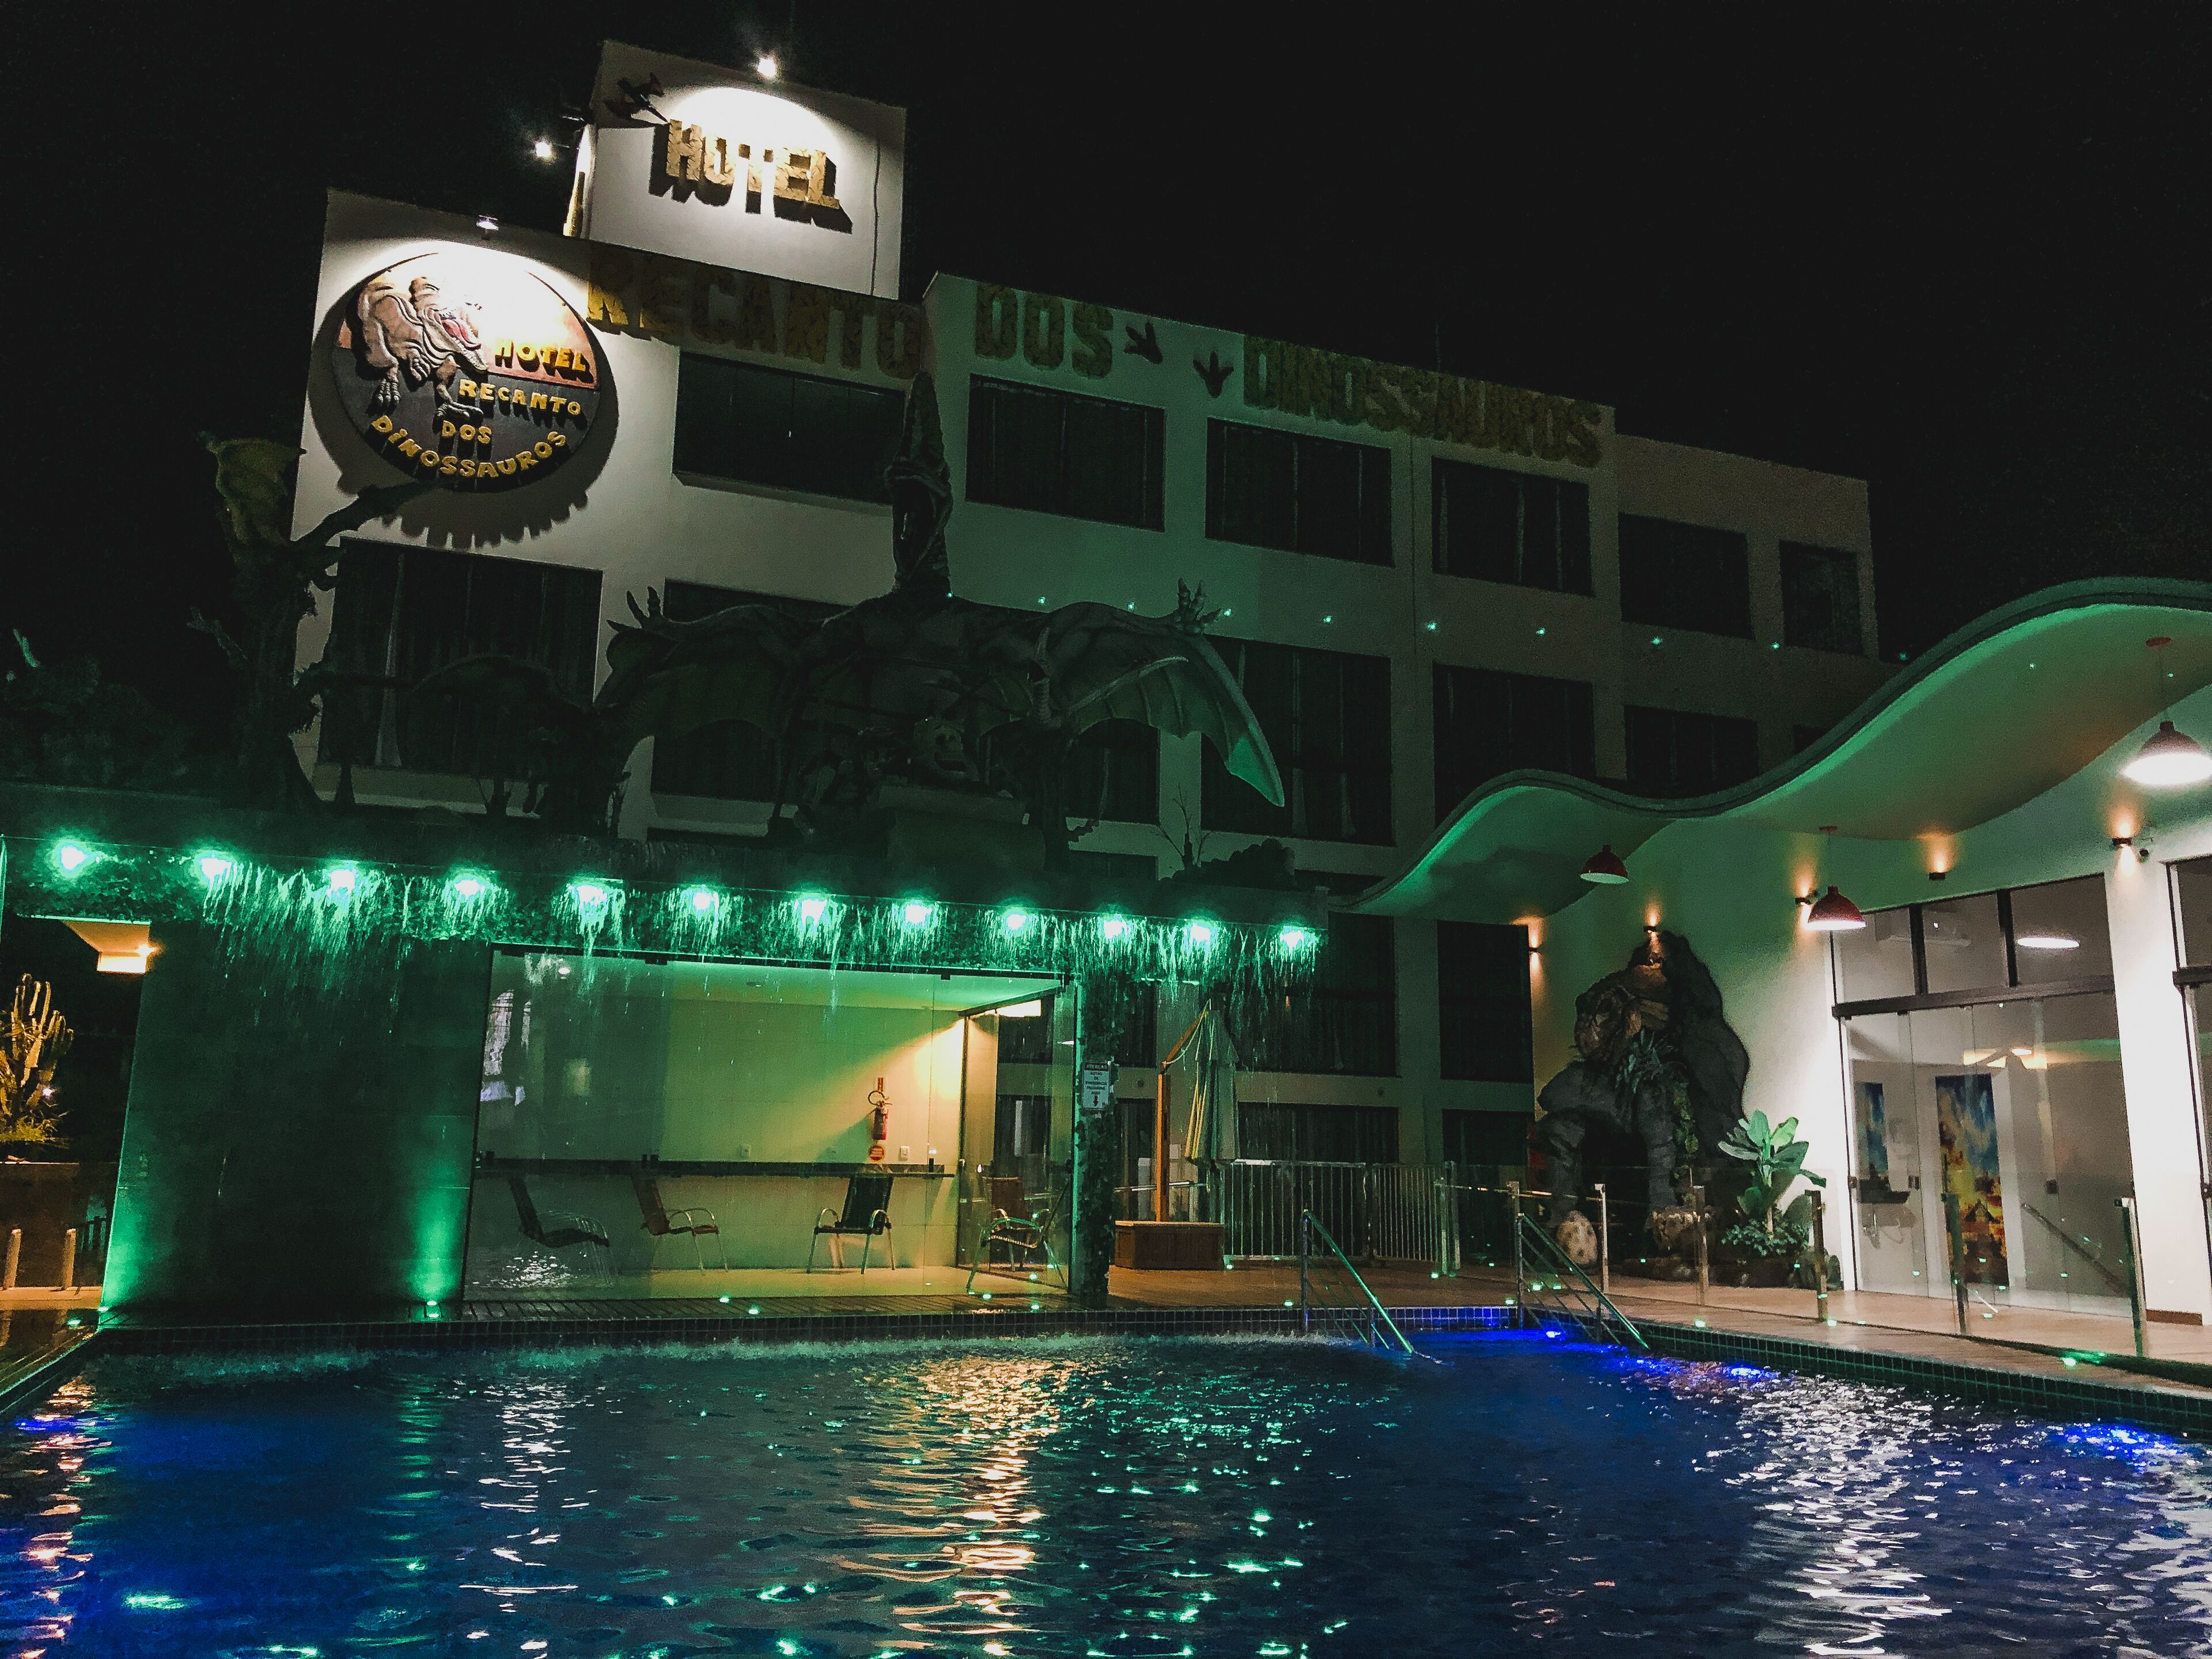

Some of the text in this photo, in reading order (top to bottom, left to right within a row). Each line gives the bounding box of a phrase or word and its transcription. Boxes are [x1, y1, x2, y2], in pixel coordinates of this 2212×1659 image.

[666, 119, 840, 210] HOTEL
[587, 247, 922, 380] RECANTO
[975, 280, 1113, 379] DOS
[494, 338, 586, 372] HOTEL
[459, 378, 581, 416] RECANTO
[441, 420, 493, 444] DOS
